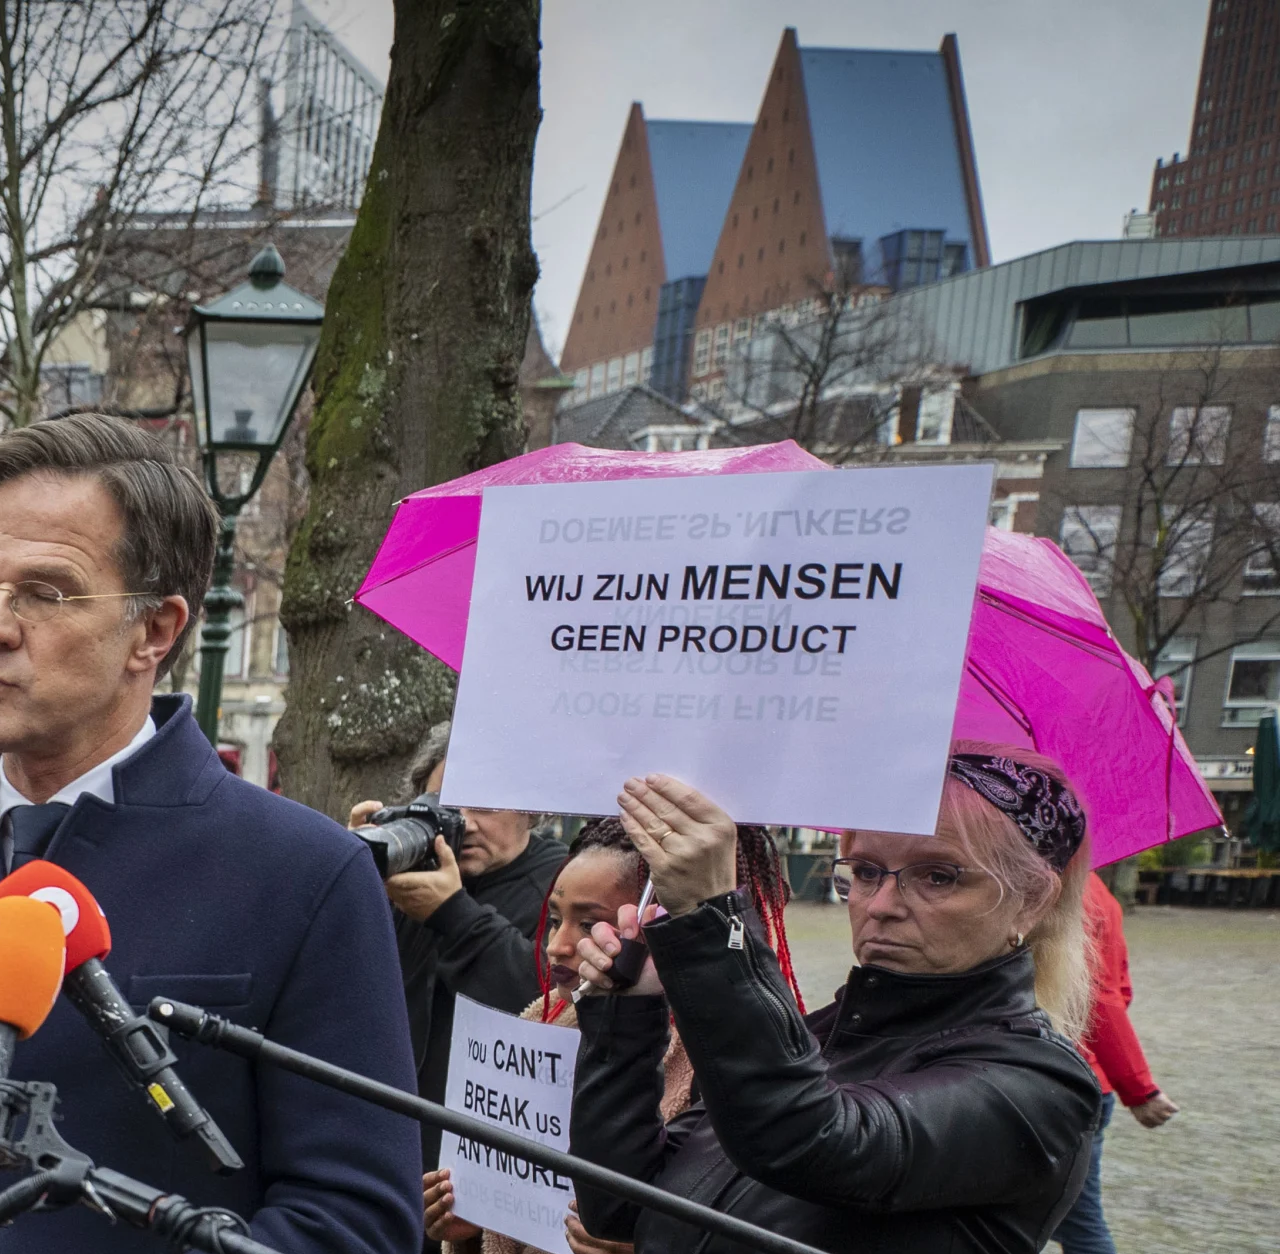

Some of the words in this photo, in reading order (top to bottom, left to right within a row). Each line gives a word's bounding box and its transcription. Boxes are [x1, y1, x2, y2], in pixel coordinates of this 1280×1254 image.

[525, 574, 584, 602] WIJ
[592, 573, 670, 602] ZIJN
[680, 562, 903, 601] MENSEN
[551, 624, 647, 652] GEEN
[657, 624, 857, 654] PRODUCT
[467, 1038, 488, 1065] YOU
[464, 1079, 531, 1132] BREAK
[536, 1112, 562, 1137] US
